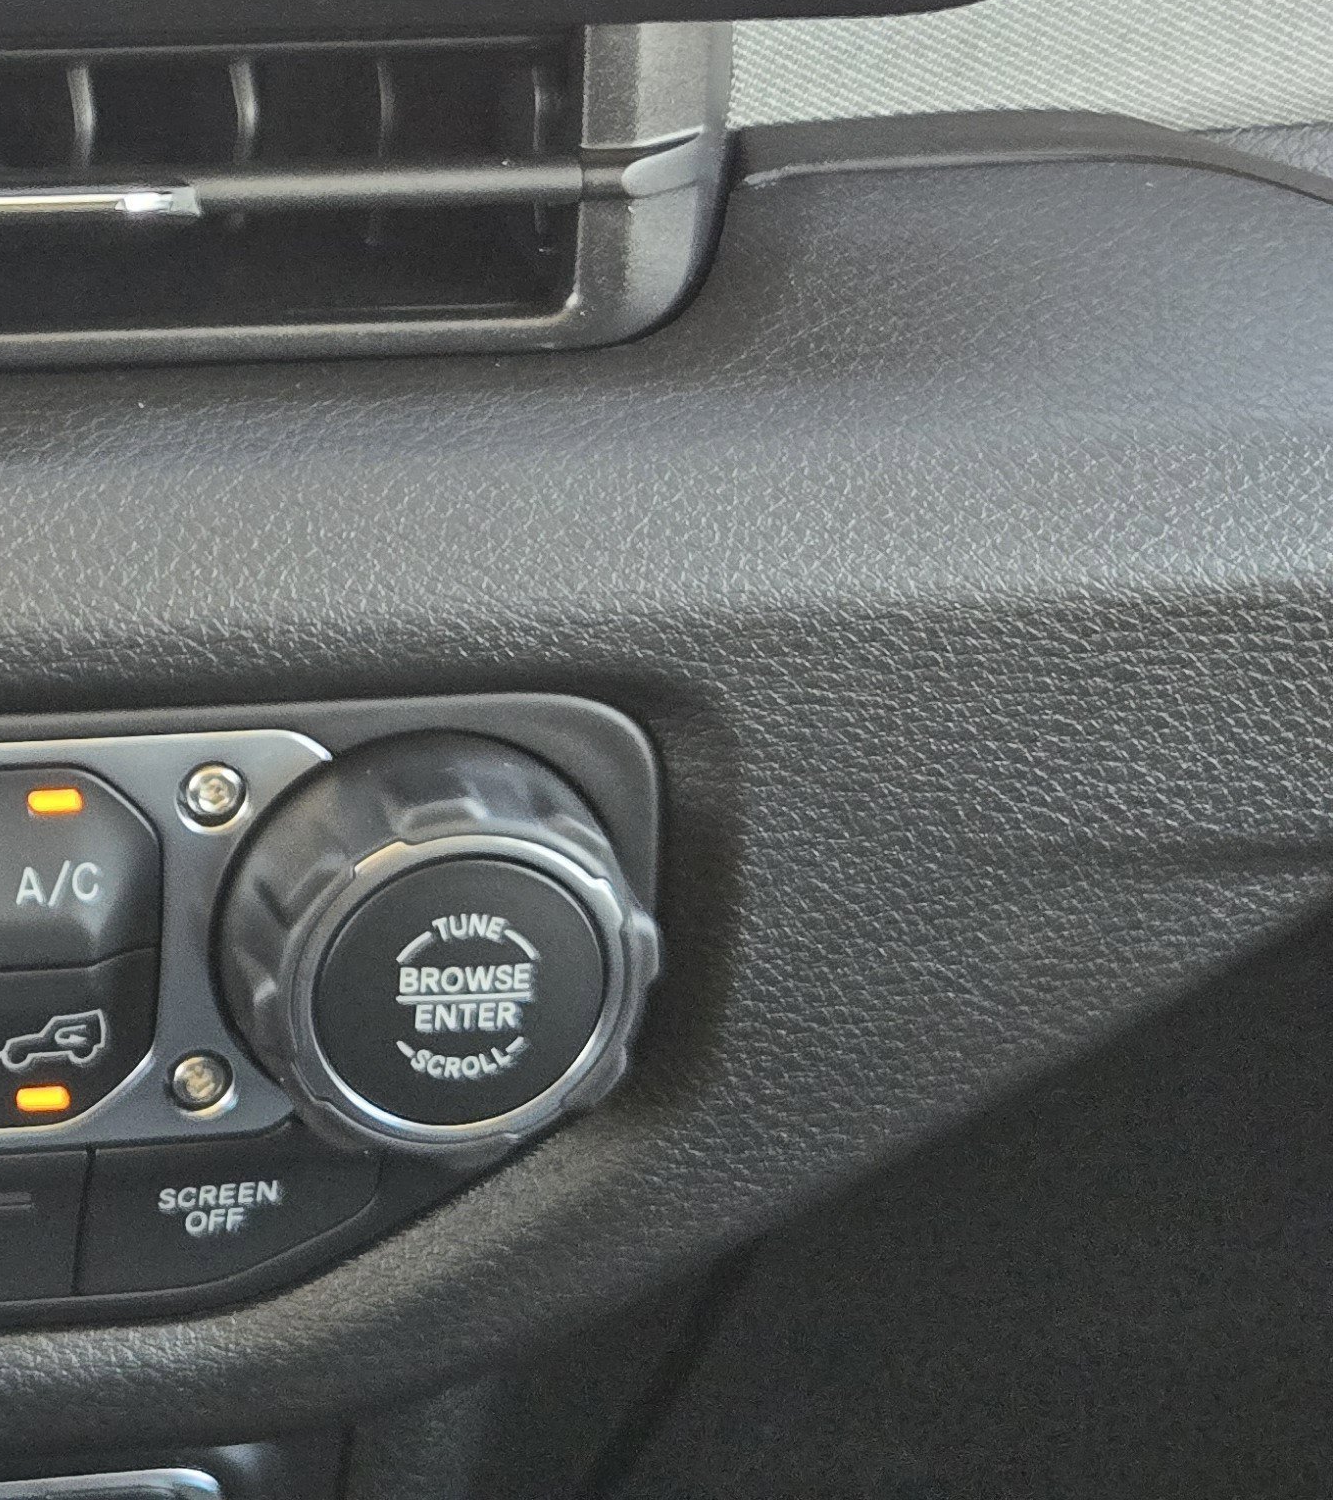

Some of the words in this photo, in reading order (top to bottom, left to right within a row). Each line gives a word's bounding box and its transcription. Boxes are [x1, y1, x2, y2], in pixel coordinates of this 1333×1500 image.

[15, 860, 101, 907] A/C
[432, 913, 506, 943] TUNE
[398, 963, 531, 994] BROWSE
[413, 1002, 519, 1032] ENTER
[410, 1047, 513, 1081] SCROLL
[158, 1181, 280, 1212] SCREEN
[184, 1206, 245, 1237] OFF
